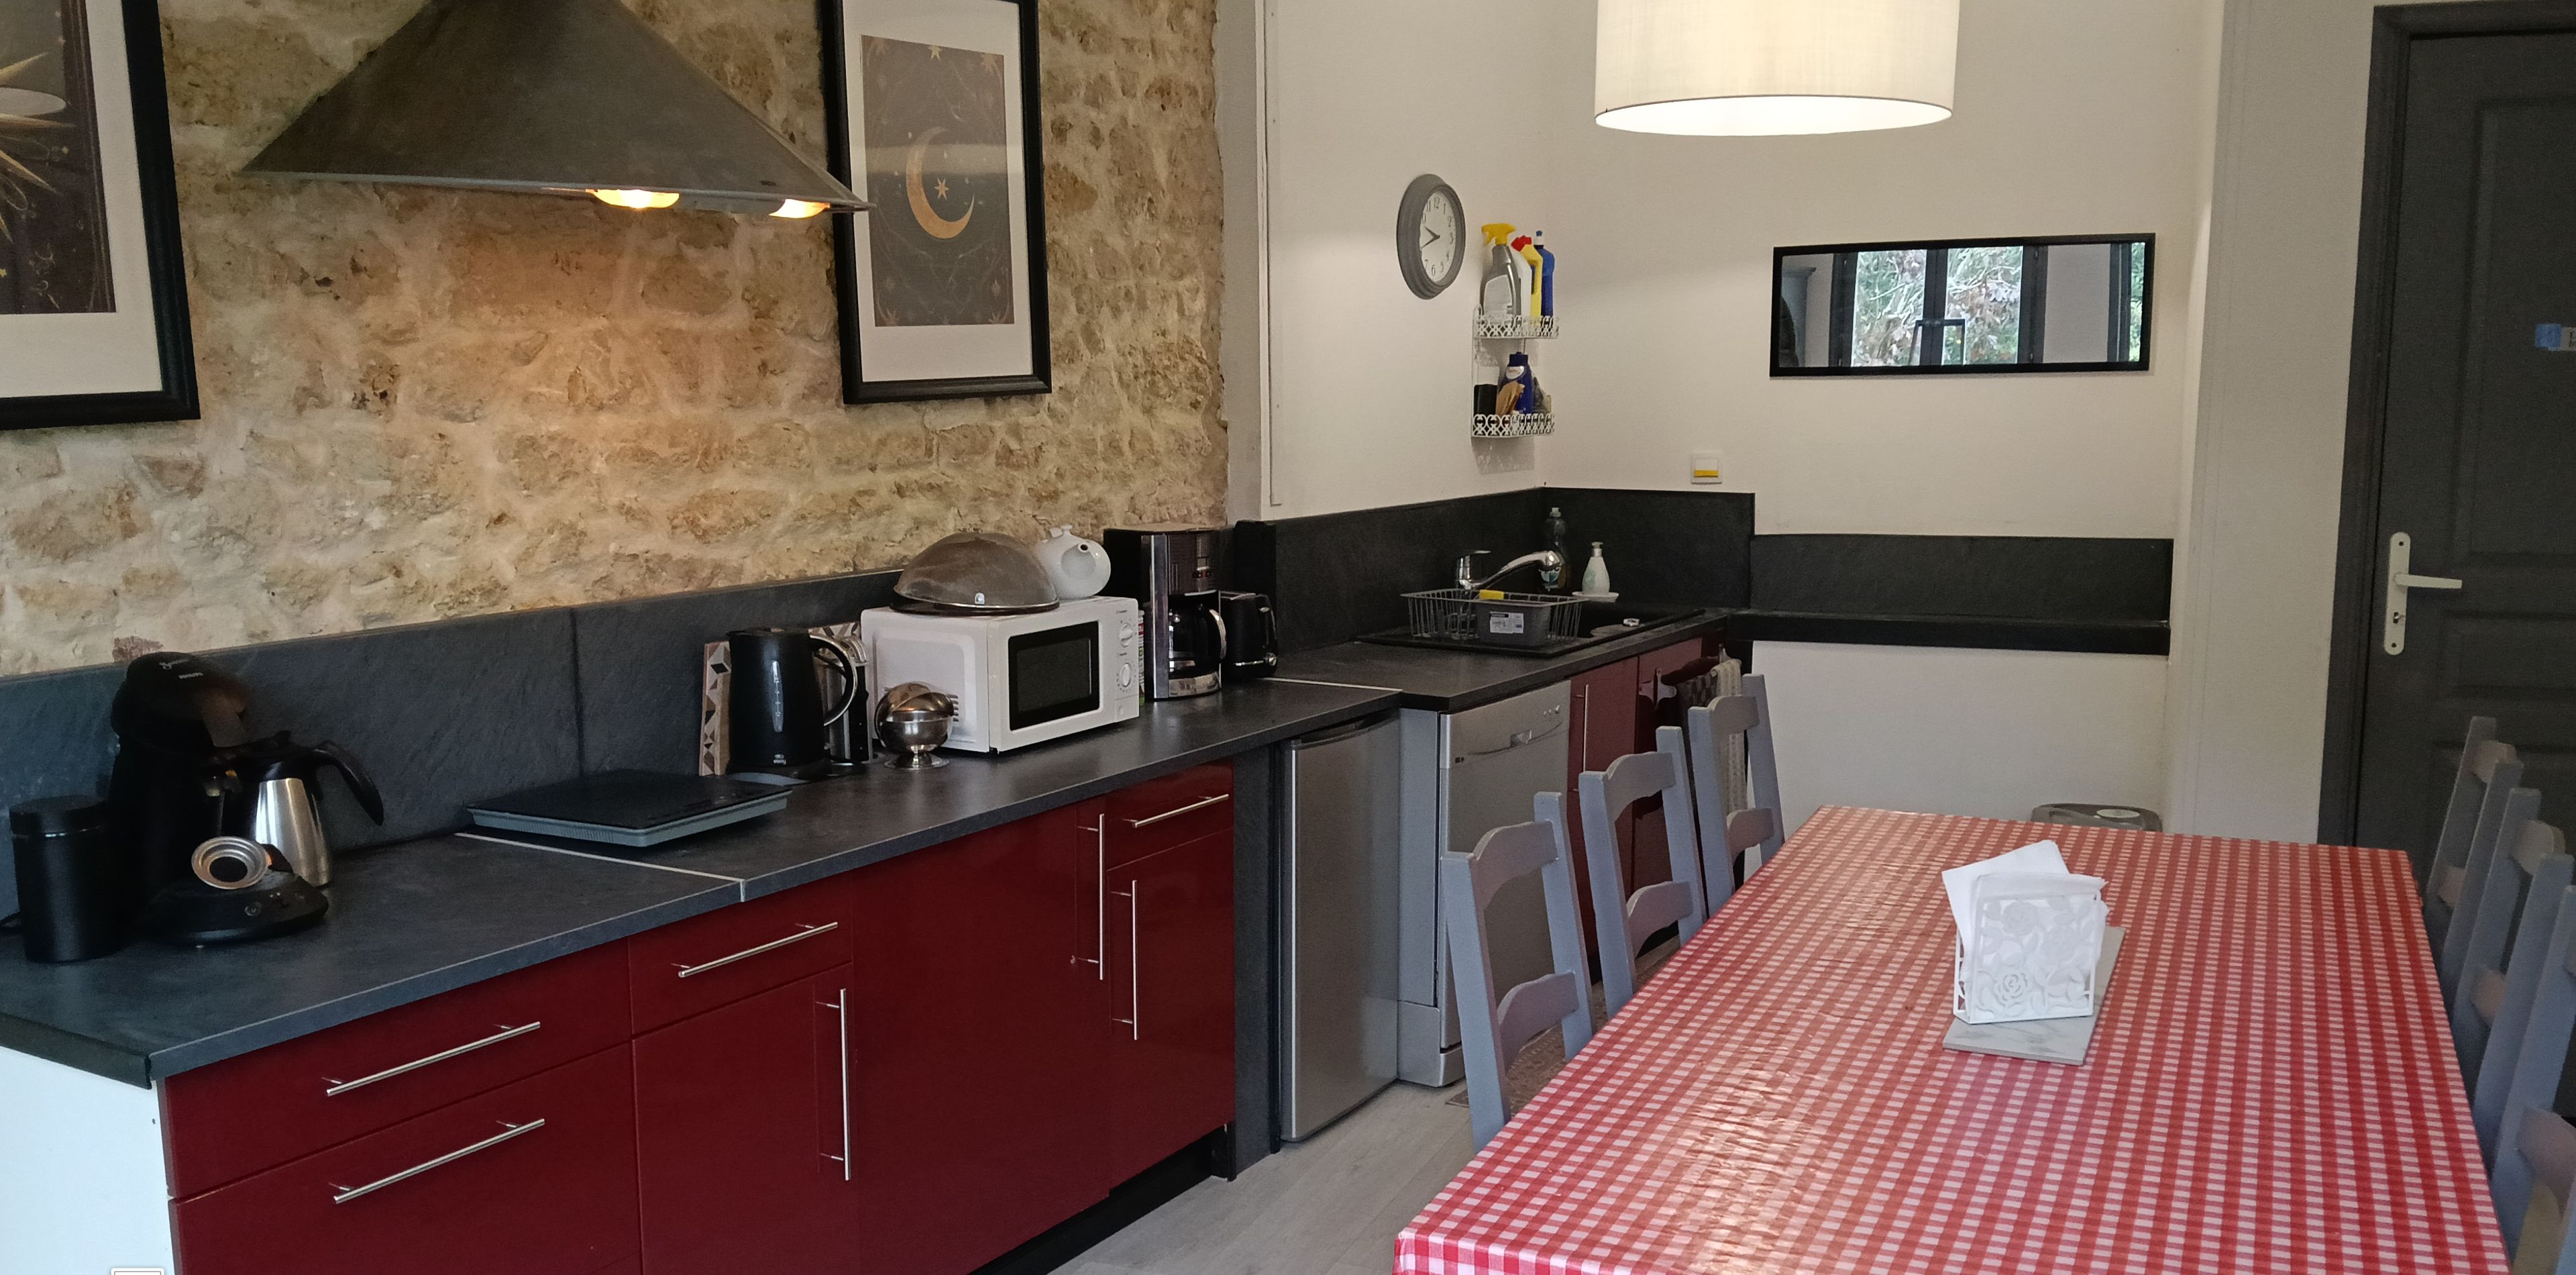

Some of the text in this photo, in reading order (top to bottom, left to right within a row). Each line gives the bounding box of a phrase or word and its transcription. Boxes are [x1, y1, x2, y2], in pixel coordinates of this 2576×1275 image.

[1434, 197, 1440, 209] 12
[1448, 215, 1452, 227] 2
[1449, 232, 1454, 244] 3
[1431, 264, 1436, 276] 6
